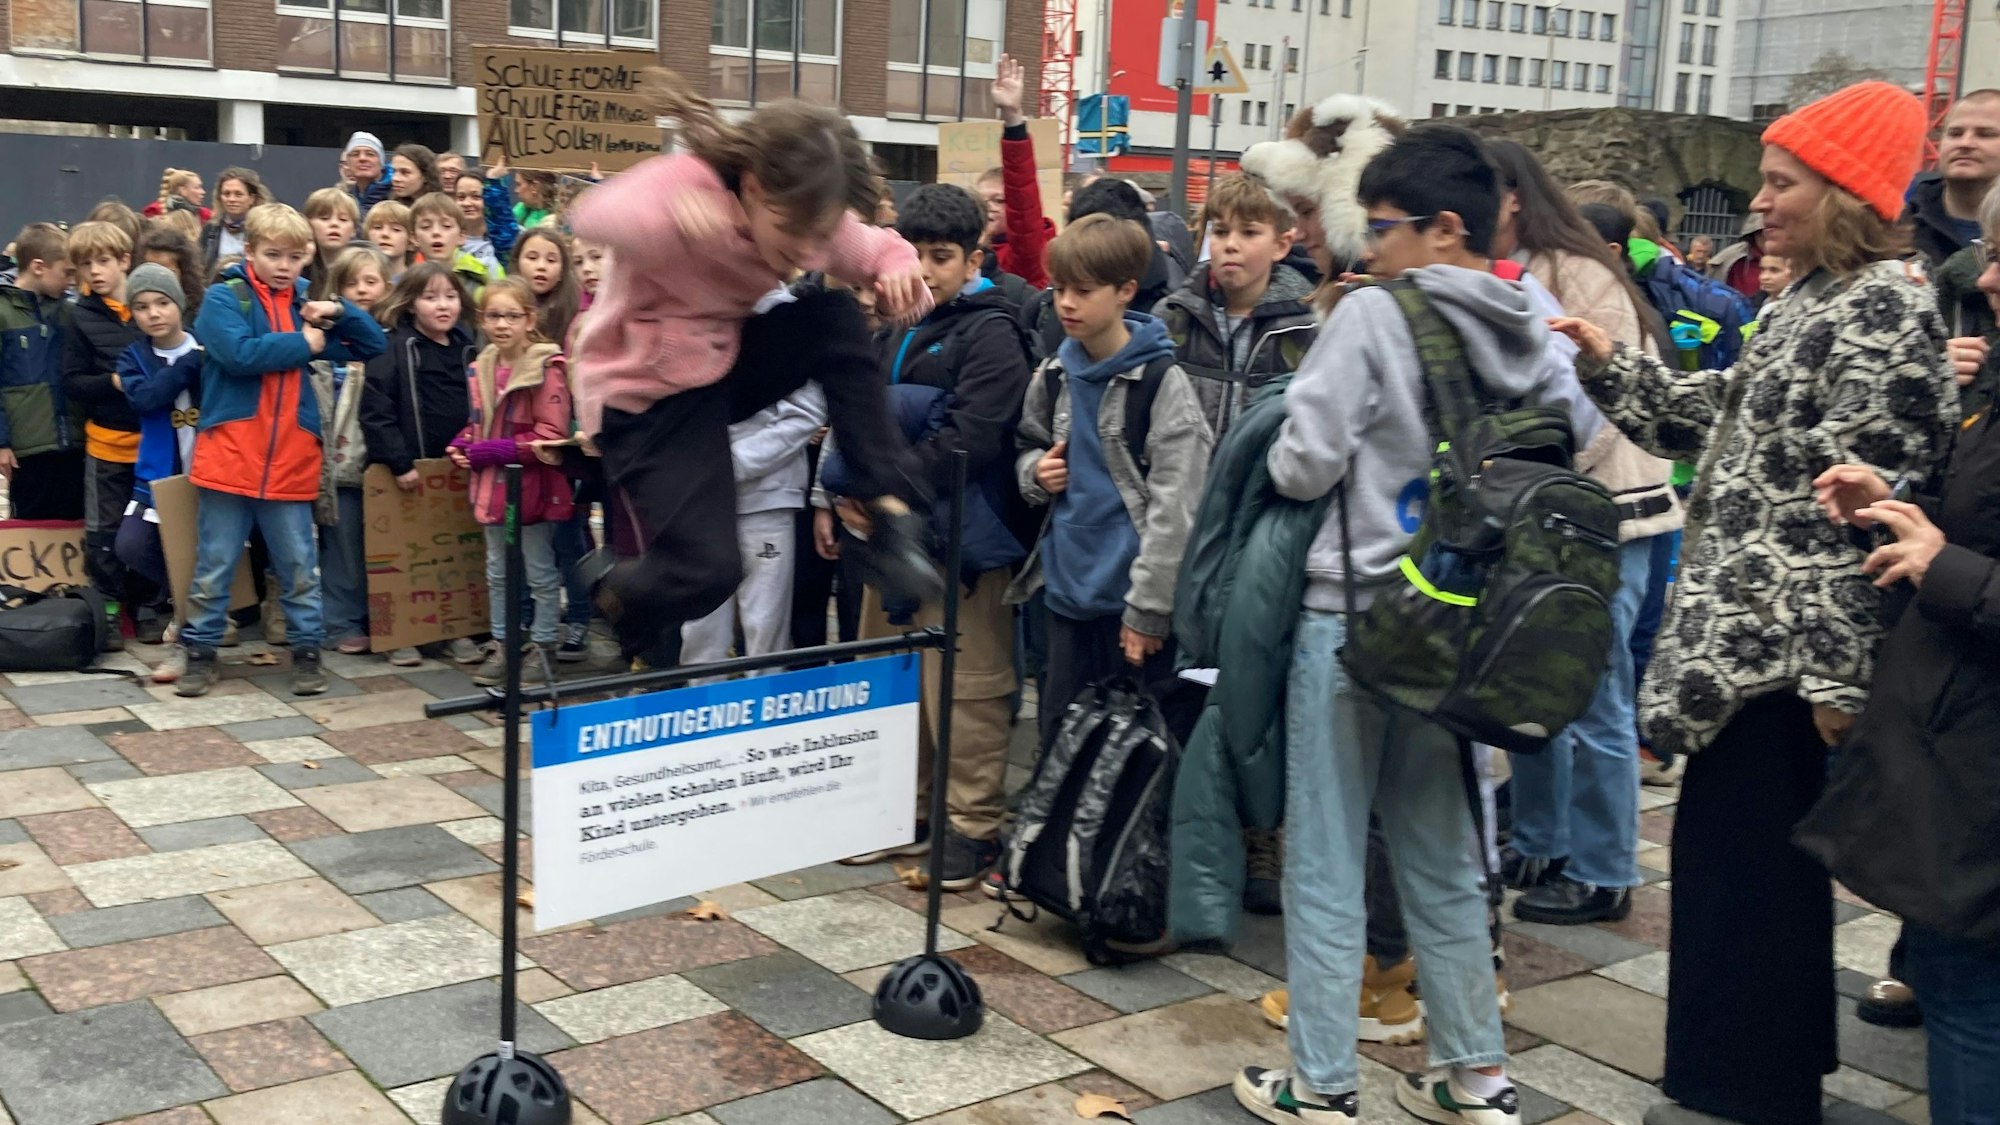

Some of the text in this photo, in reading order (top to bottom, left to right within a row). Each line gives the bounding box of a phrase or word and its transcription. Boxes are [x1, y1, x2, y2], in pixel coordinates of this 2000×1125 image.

[577, 680, 871, 754] ENTMUTIGENDE BERATUNG
[579, 779, 611, 795] Kita,
[745, 748, 766, 763] So
[769, 741, 800, 758] wie
[802, 729, 879, 753] Inklusion
[580, 753, 856, 819] an vielen Schulen läuft, wird Ihr
[579, 819, 627, 843] Kind
[629, 802, 735, 826] untergehen.
